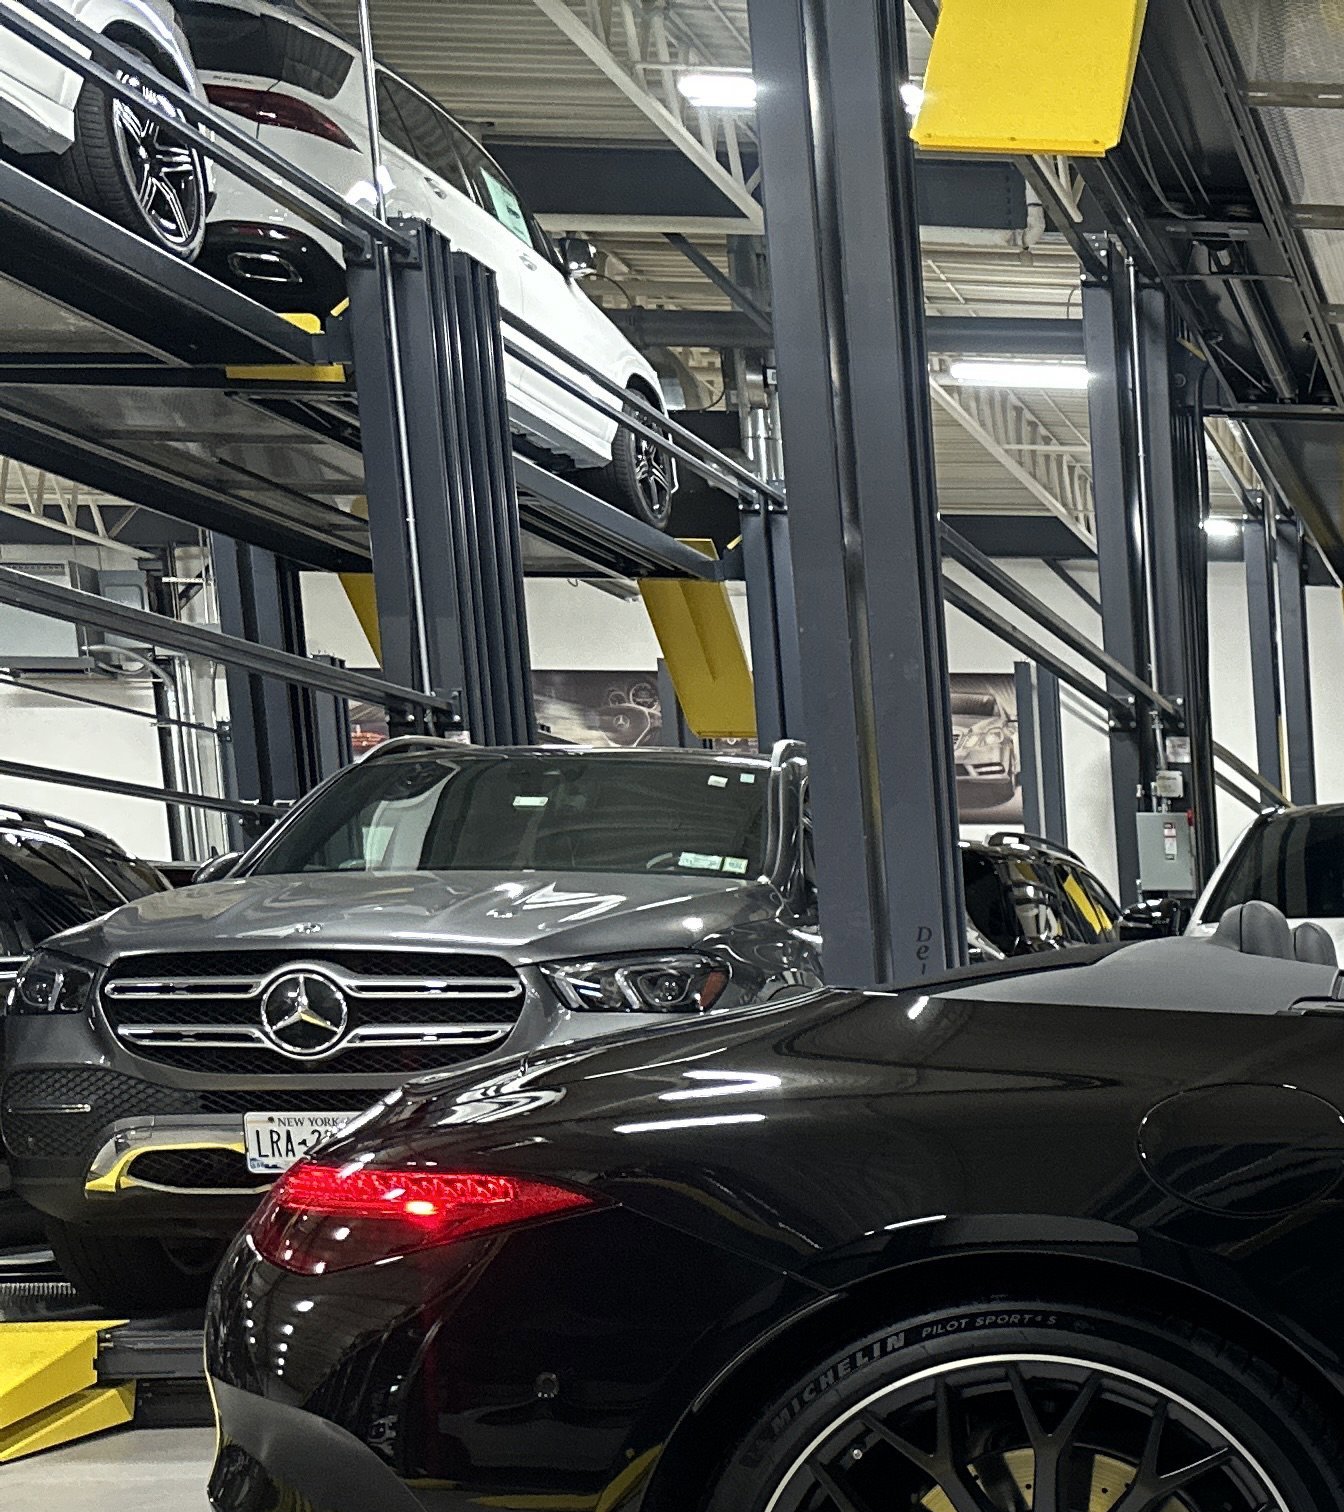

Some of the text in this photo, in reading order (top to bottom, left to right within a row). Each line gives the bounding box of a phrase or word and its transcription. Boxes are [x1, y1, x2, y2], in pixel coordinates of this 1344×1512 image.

[277, 1117, 340, 1127] NEW YORK
[770, 1333, 906, 1433] MICHELIN
[922, 1318, 969, 1338] PILOT
